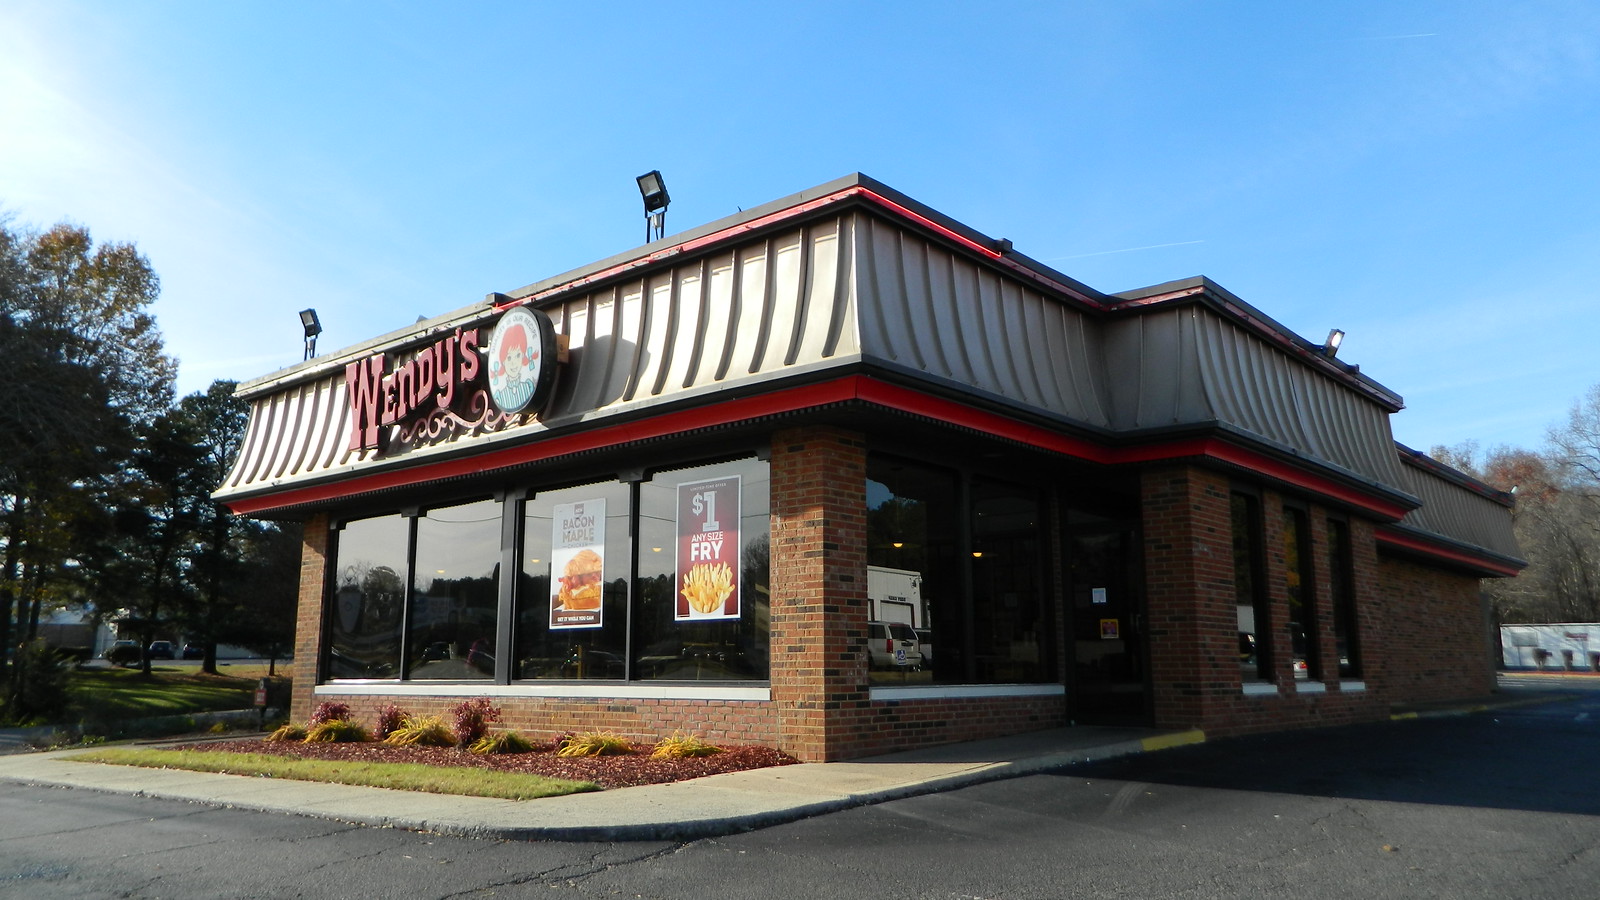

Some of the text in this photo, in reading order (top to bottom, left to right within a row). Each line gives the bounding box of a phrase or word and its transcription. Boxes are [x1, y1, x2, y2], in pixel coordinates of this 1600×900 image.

[524, 317, 538, 340] RECIPE
[692, 491, 720, 532] $1
[563, 515, 595, 530] BACON
[562, 528, 595, 543] MAPLE
[691, 531, 723, 543] ANY SIZE
[690, 540, 723, 562] FRY
